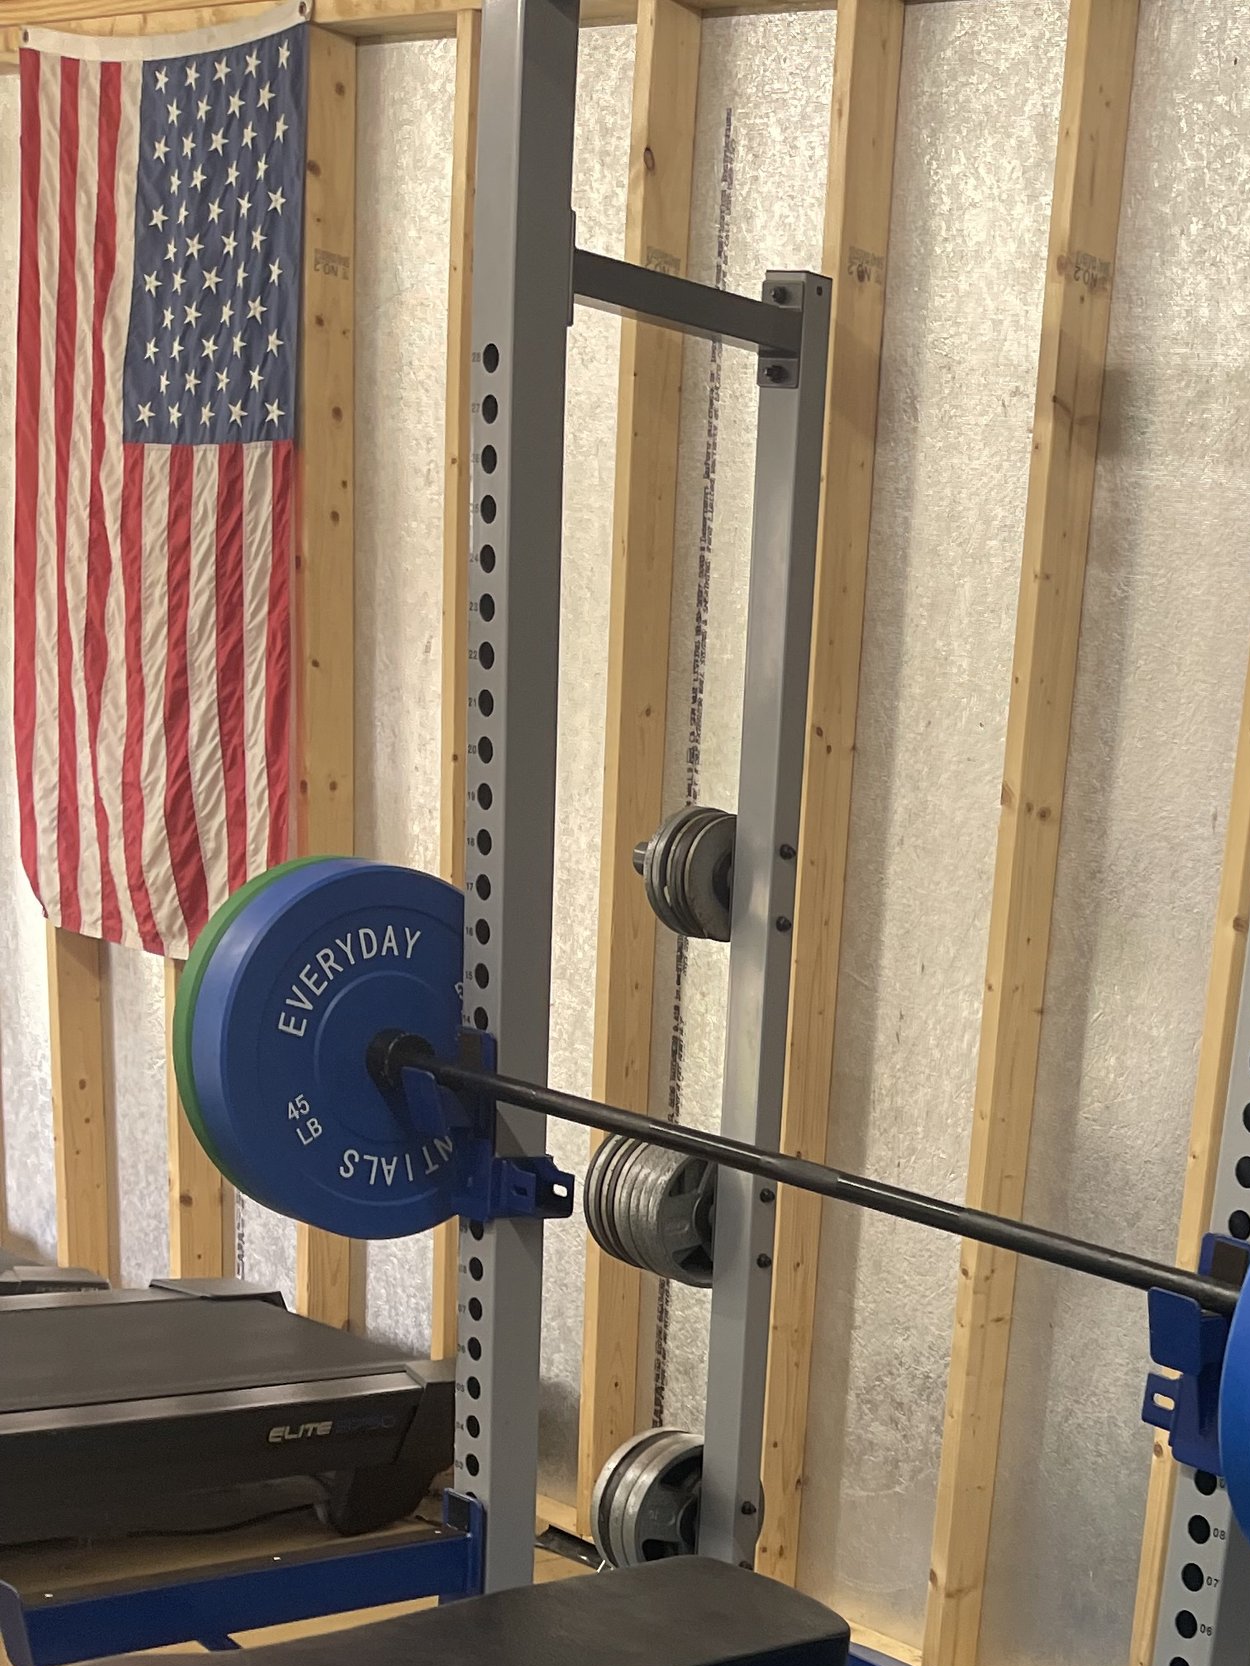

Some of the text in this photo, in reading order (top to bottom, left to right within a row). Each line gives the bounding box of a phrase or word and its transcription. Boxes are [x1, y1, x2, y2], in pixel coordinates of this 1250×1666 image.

[278, 925, 422, 1037] EVERYDAY
[287, 1093, 311, 1121] 45
[296, 1117, 323, 1146] LB
[267, 1420, 334, 1444] ELITE
[1206, 1575, 1220, 1588] 07
